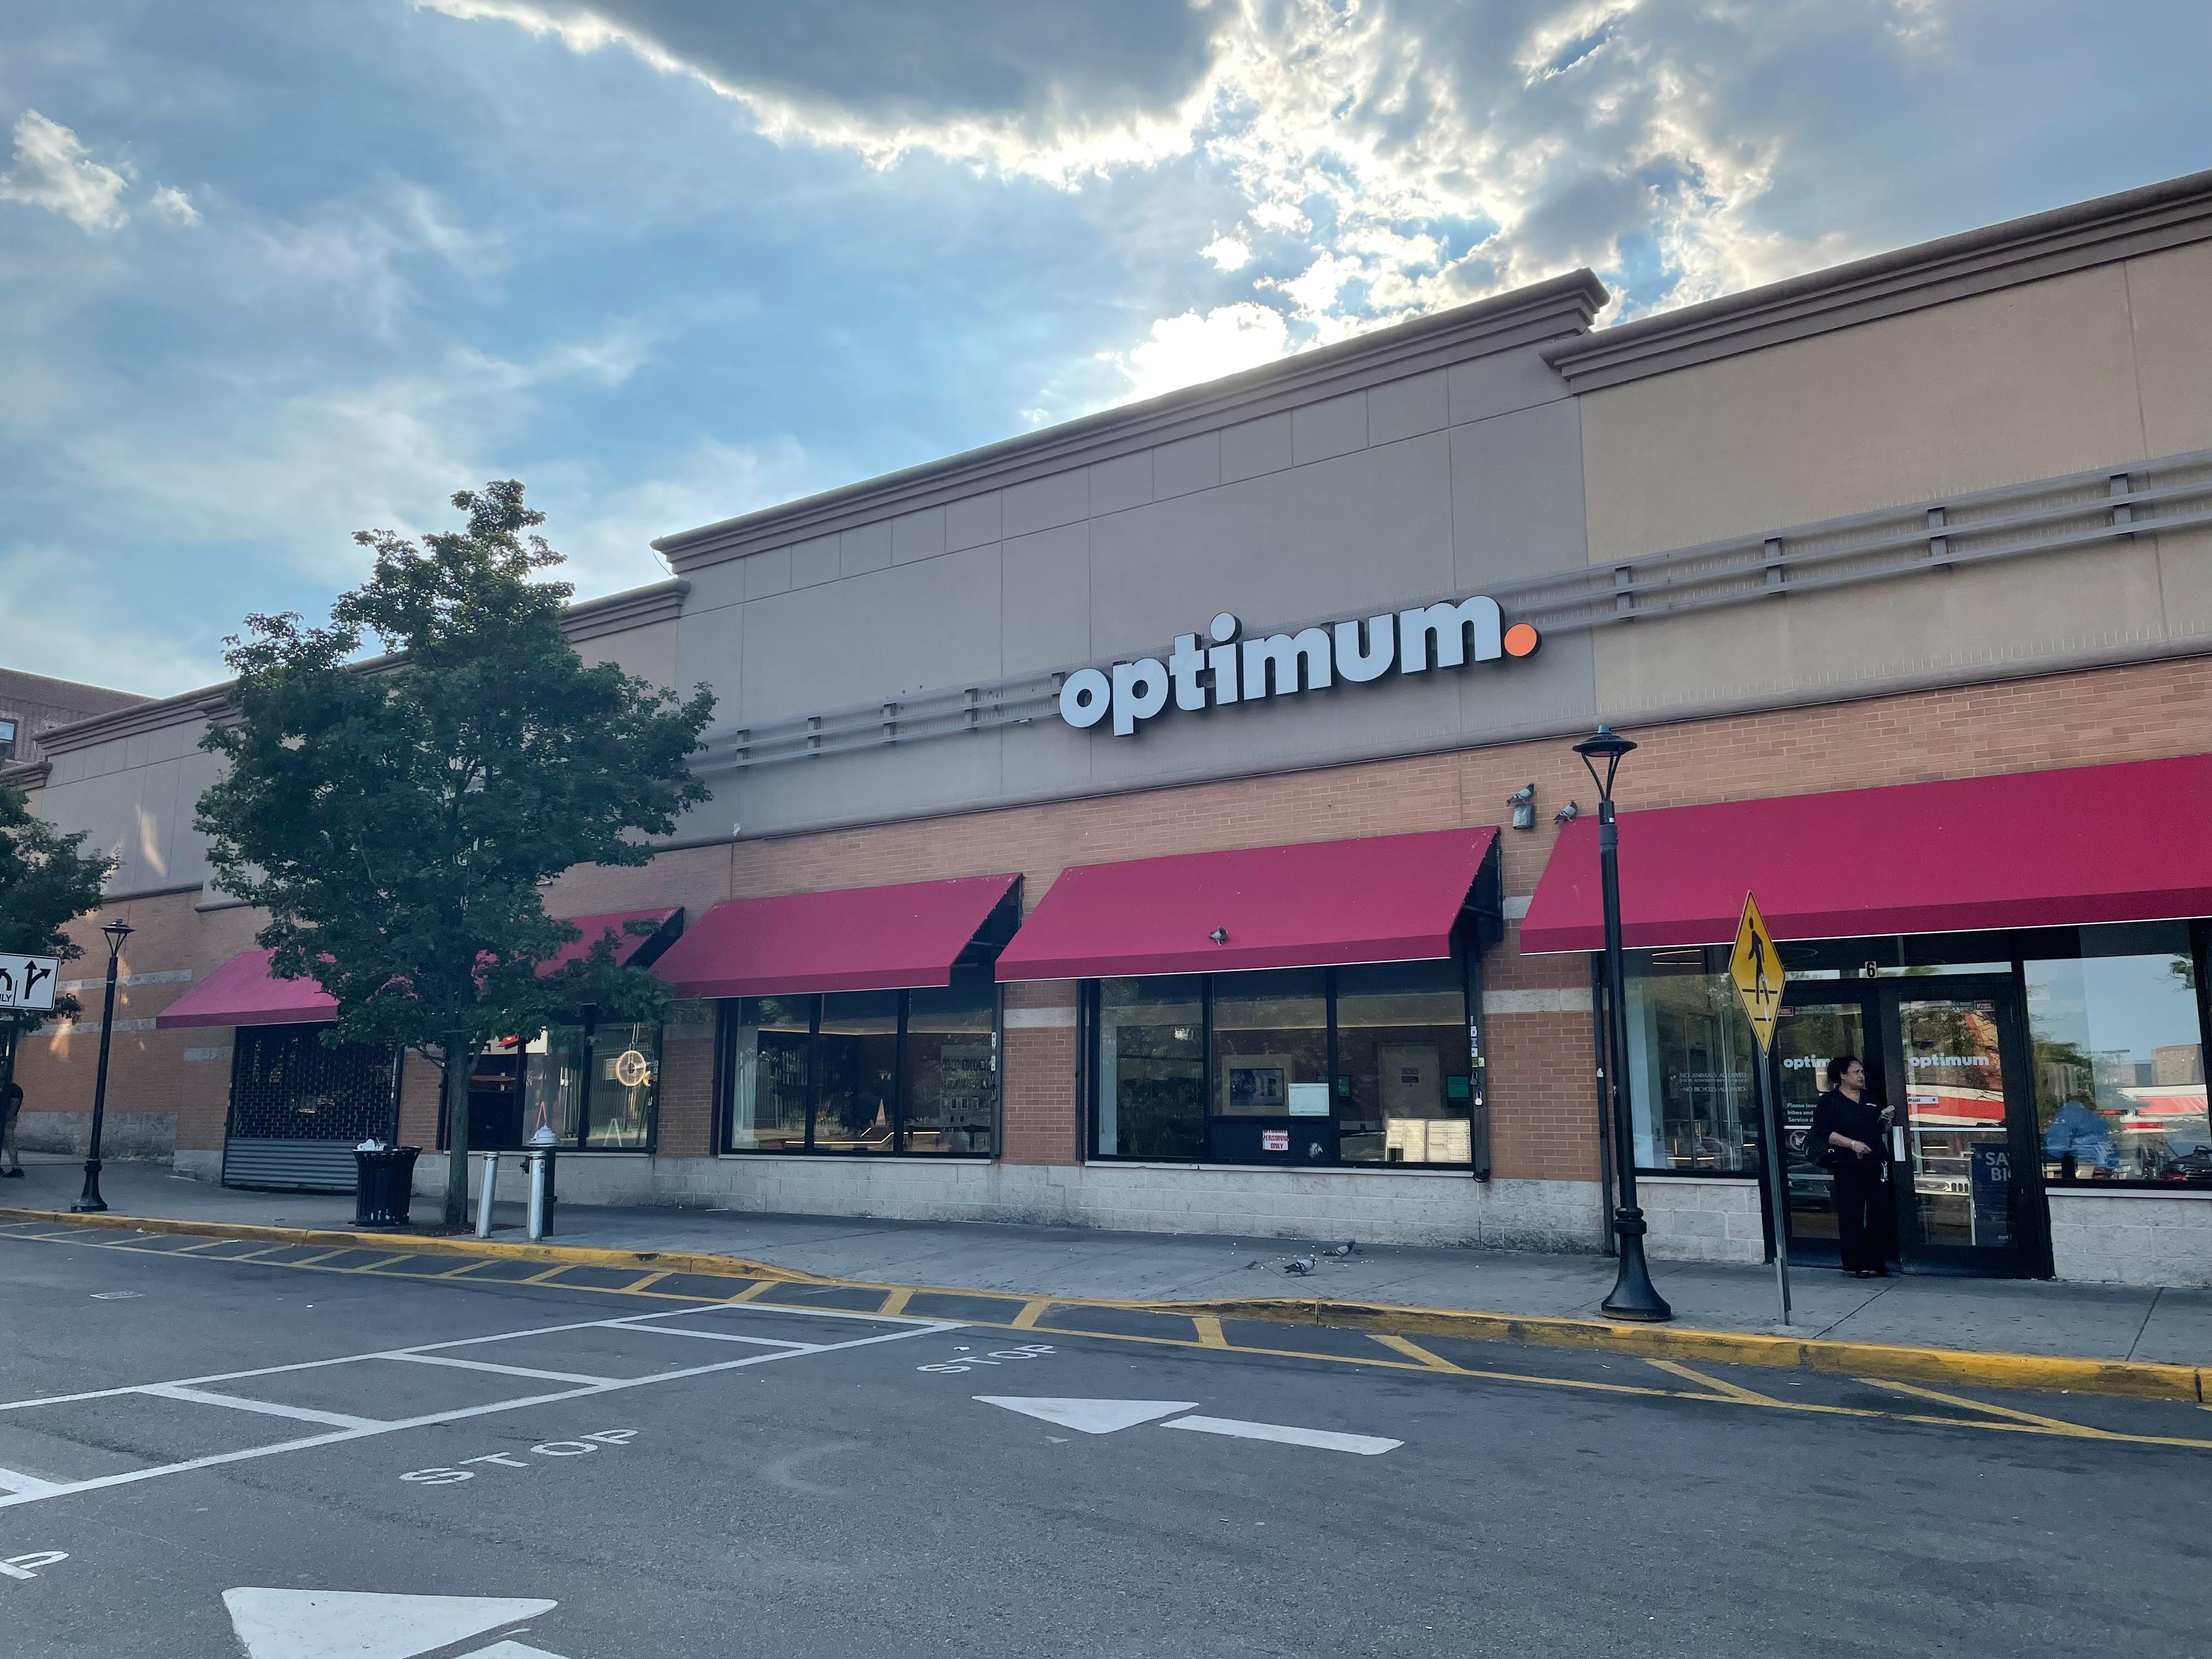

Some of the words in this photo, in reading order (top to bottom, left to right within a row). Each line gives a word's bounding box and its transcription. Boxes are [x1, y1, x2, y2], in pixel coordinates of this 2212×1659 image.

[1059, 595, 1537, 737] optimum.
[1867, 962, 1875, 977] 6
[1784, 1054, 1833, 1069] optim
[1909, 1052, 1990, 1068] optimum
[1991, 1167, 2011, 1181] BI
[916, 1344, 1057, 1373] STOP
[398, 1429, 639, 1485] STOP
